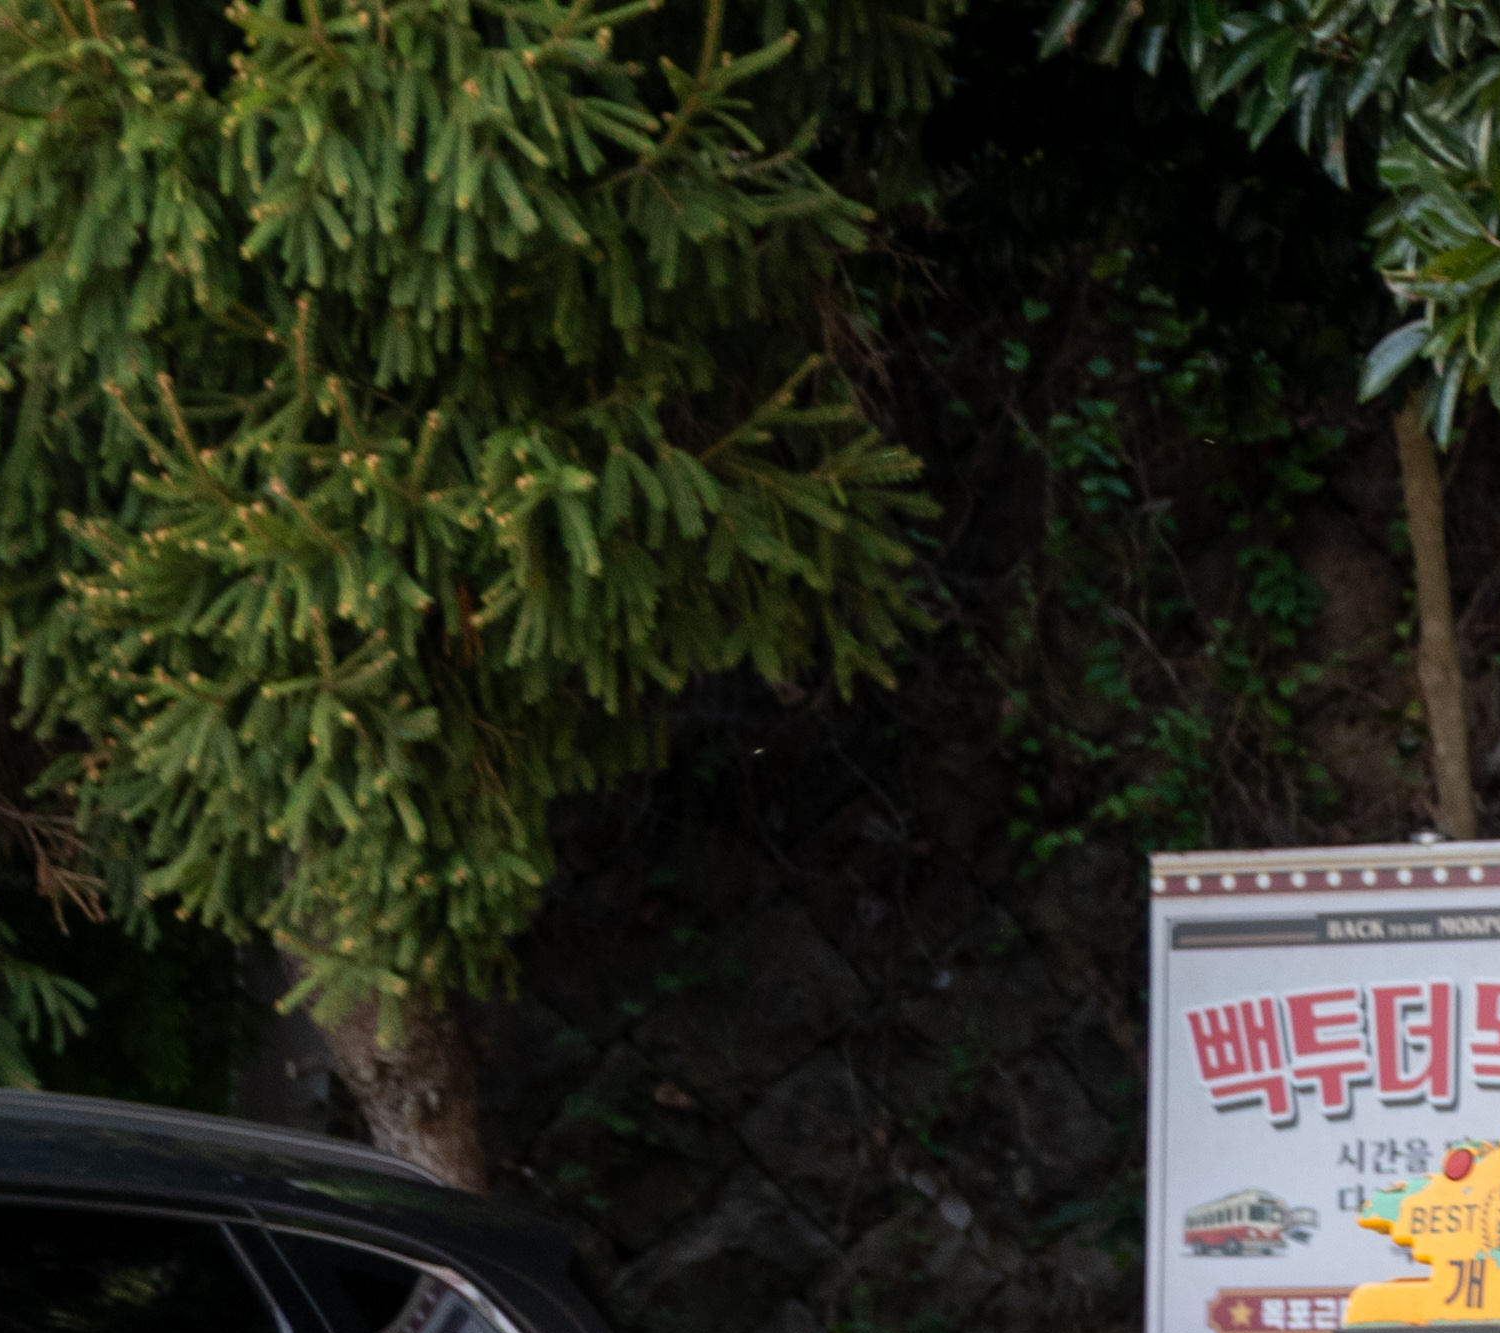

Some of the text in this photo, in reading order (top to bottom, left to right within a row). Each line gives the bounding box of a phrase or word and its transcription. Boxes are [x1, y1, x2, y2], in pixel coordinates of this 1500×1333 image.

[1326, 919, 1385, 939] BACK
[1337, 1137, 1432, 1174] 시간을
[1409, 1203, 1479, 1235] BEST
